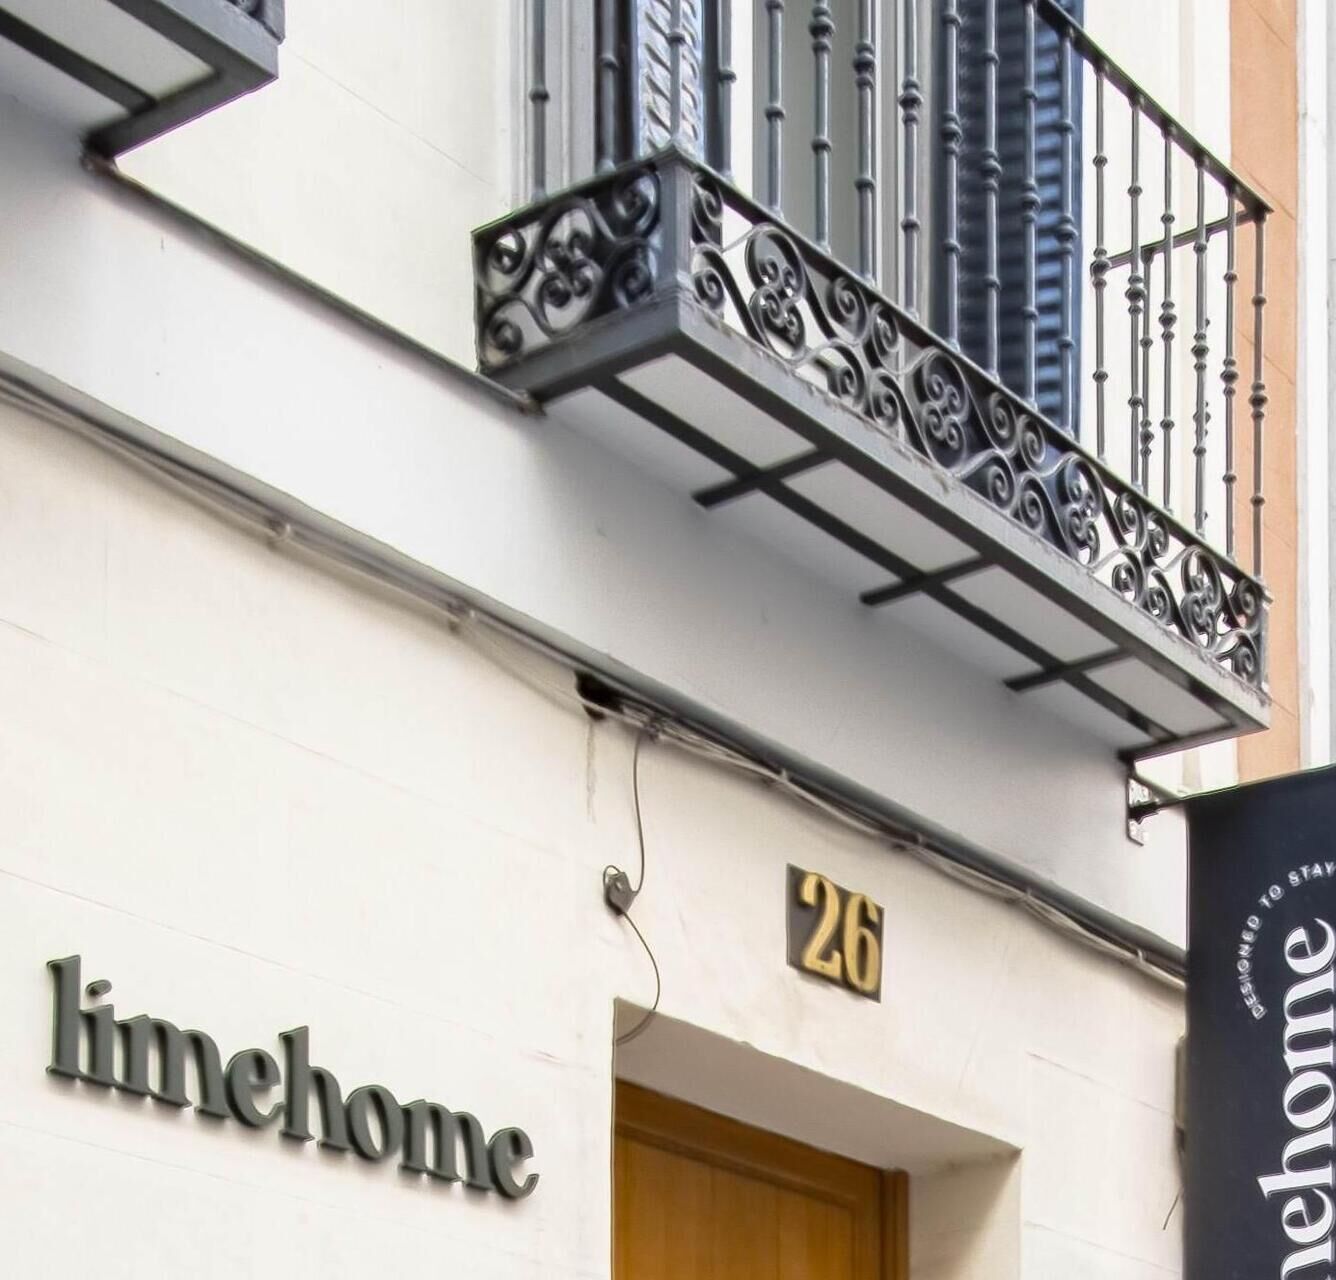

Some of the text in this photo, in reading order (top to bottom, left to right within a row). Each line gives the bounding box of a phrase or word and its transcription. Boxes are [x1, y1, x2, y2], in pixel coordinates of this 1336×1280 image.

[800, 871, 881, 993] 26
[1237, 915, 1268, 1020] DESIGNED
[1258, 884, 1284, 909] TO
[46, 954, 540, 1200] limehome
